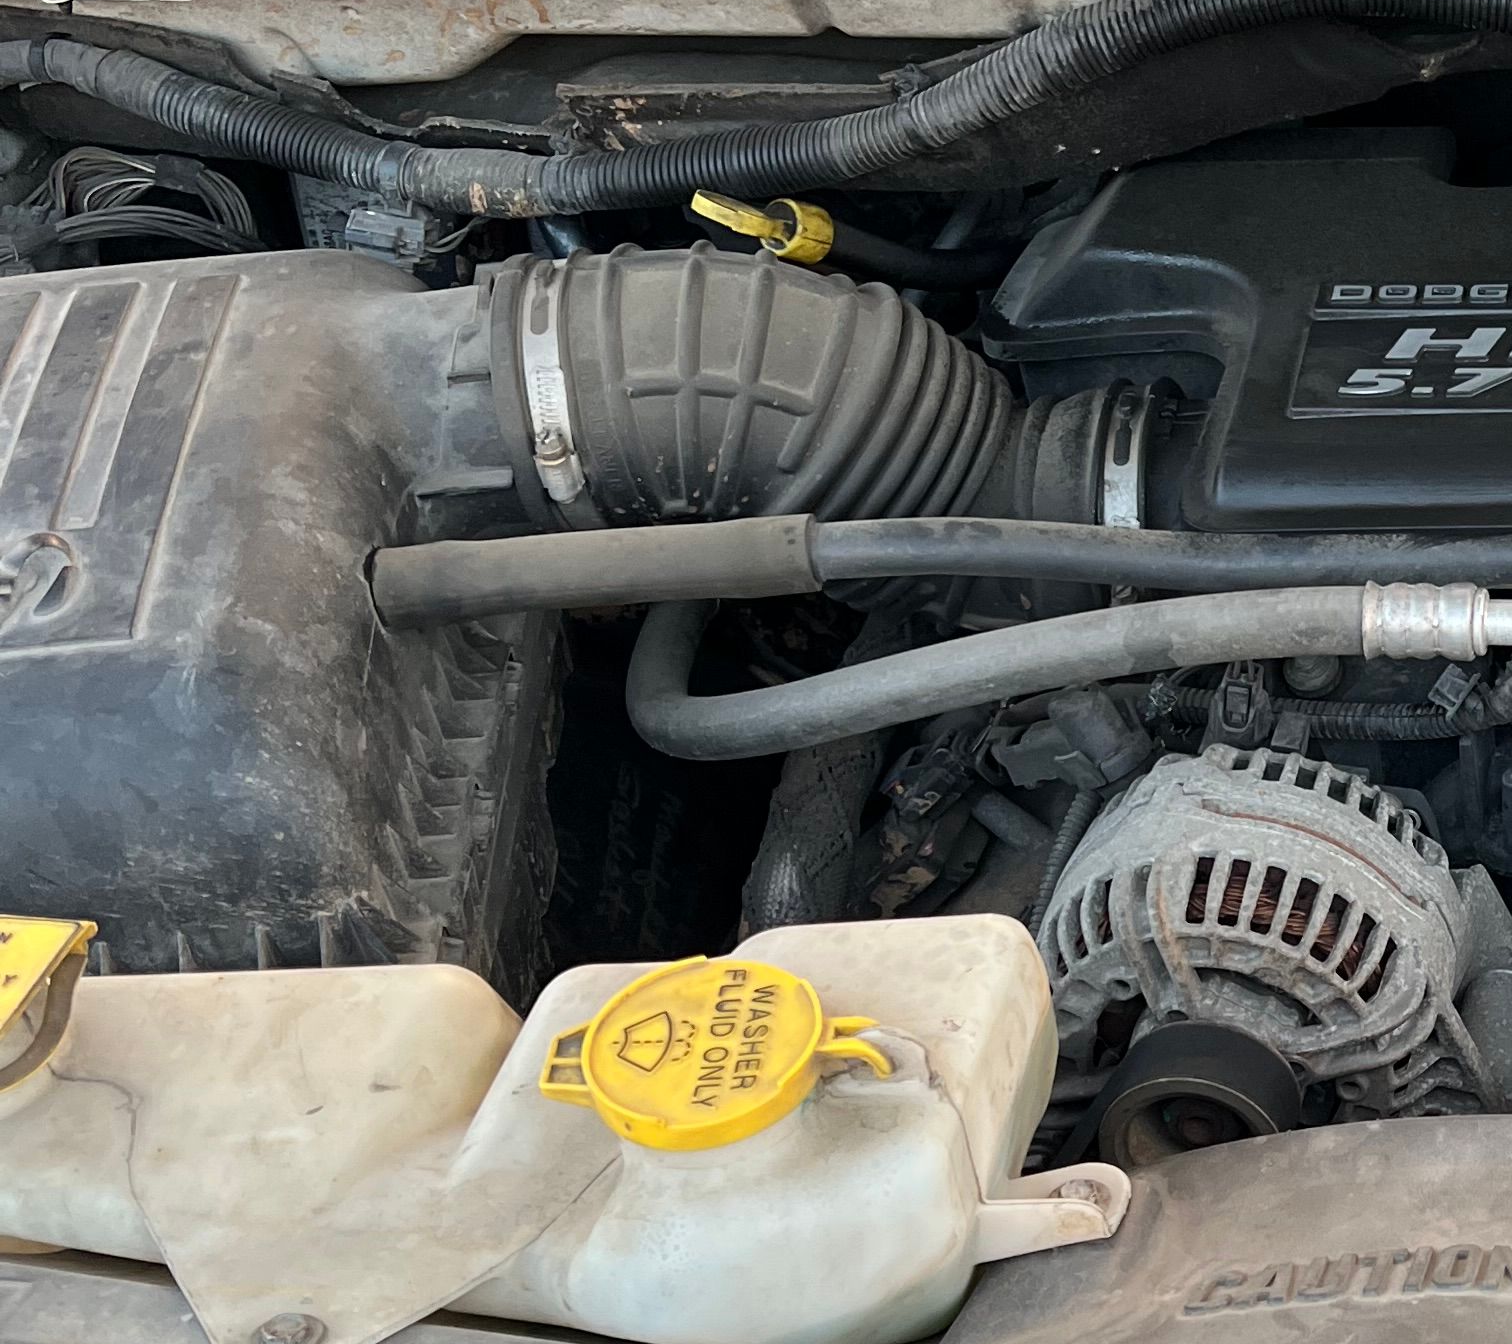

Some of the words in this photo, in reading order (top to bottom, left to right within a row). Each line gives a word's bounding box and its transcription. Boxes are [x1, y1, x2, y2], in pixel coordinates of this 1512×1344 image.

[708, 968, 748, 1038] FLUID
[729, 984, 780, 1091] WASHER
[690, 1045, 730, 1108] ONLY
